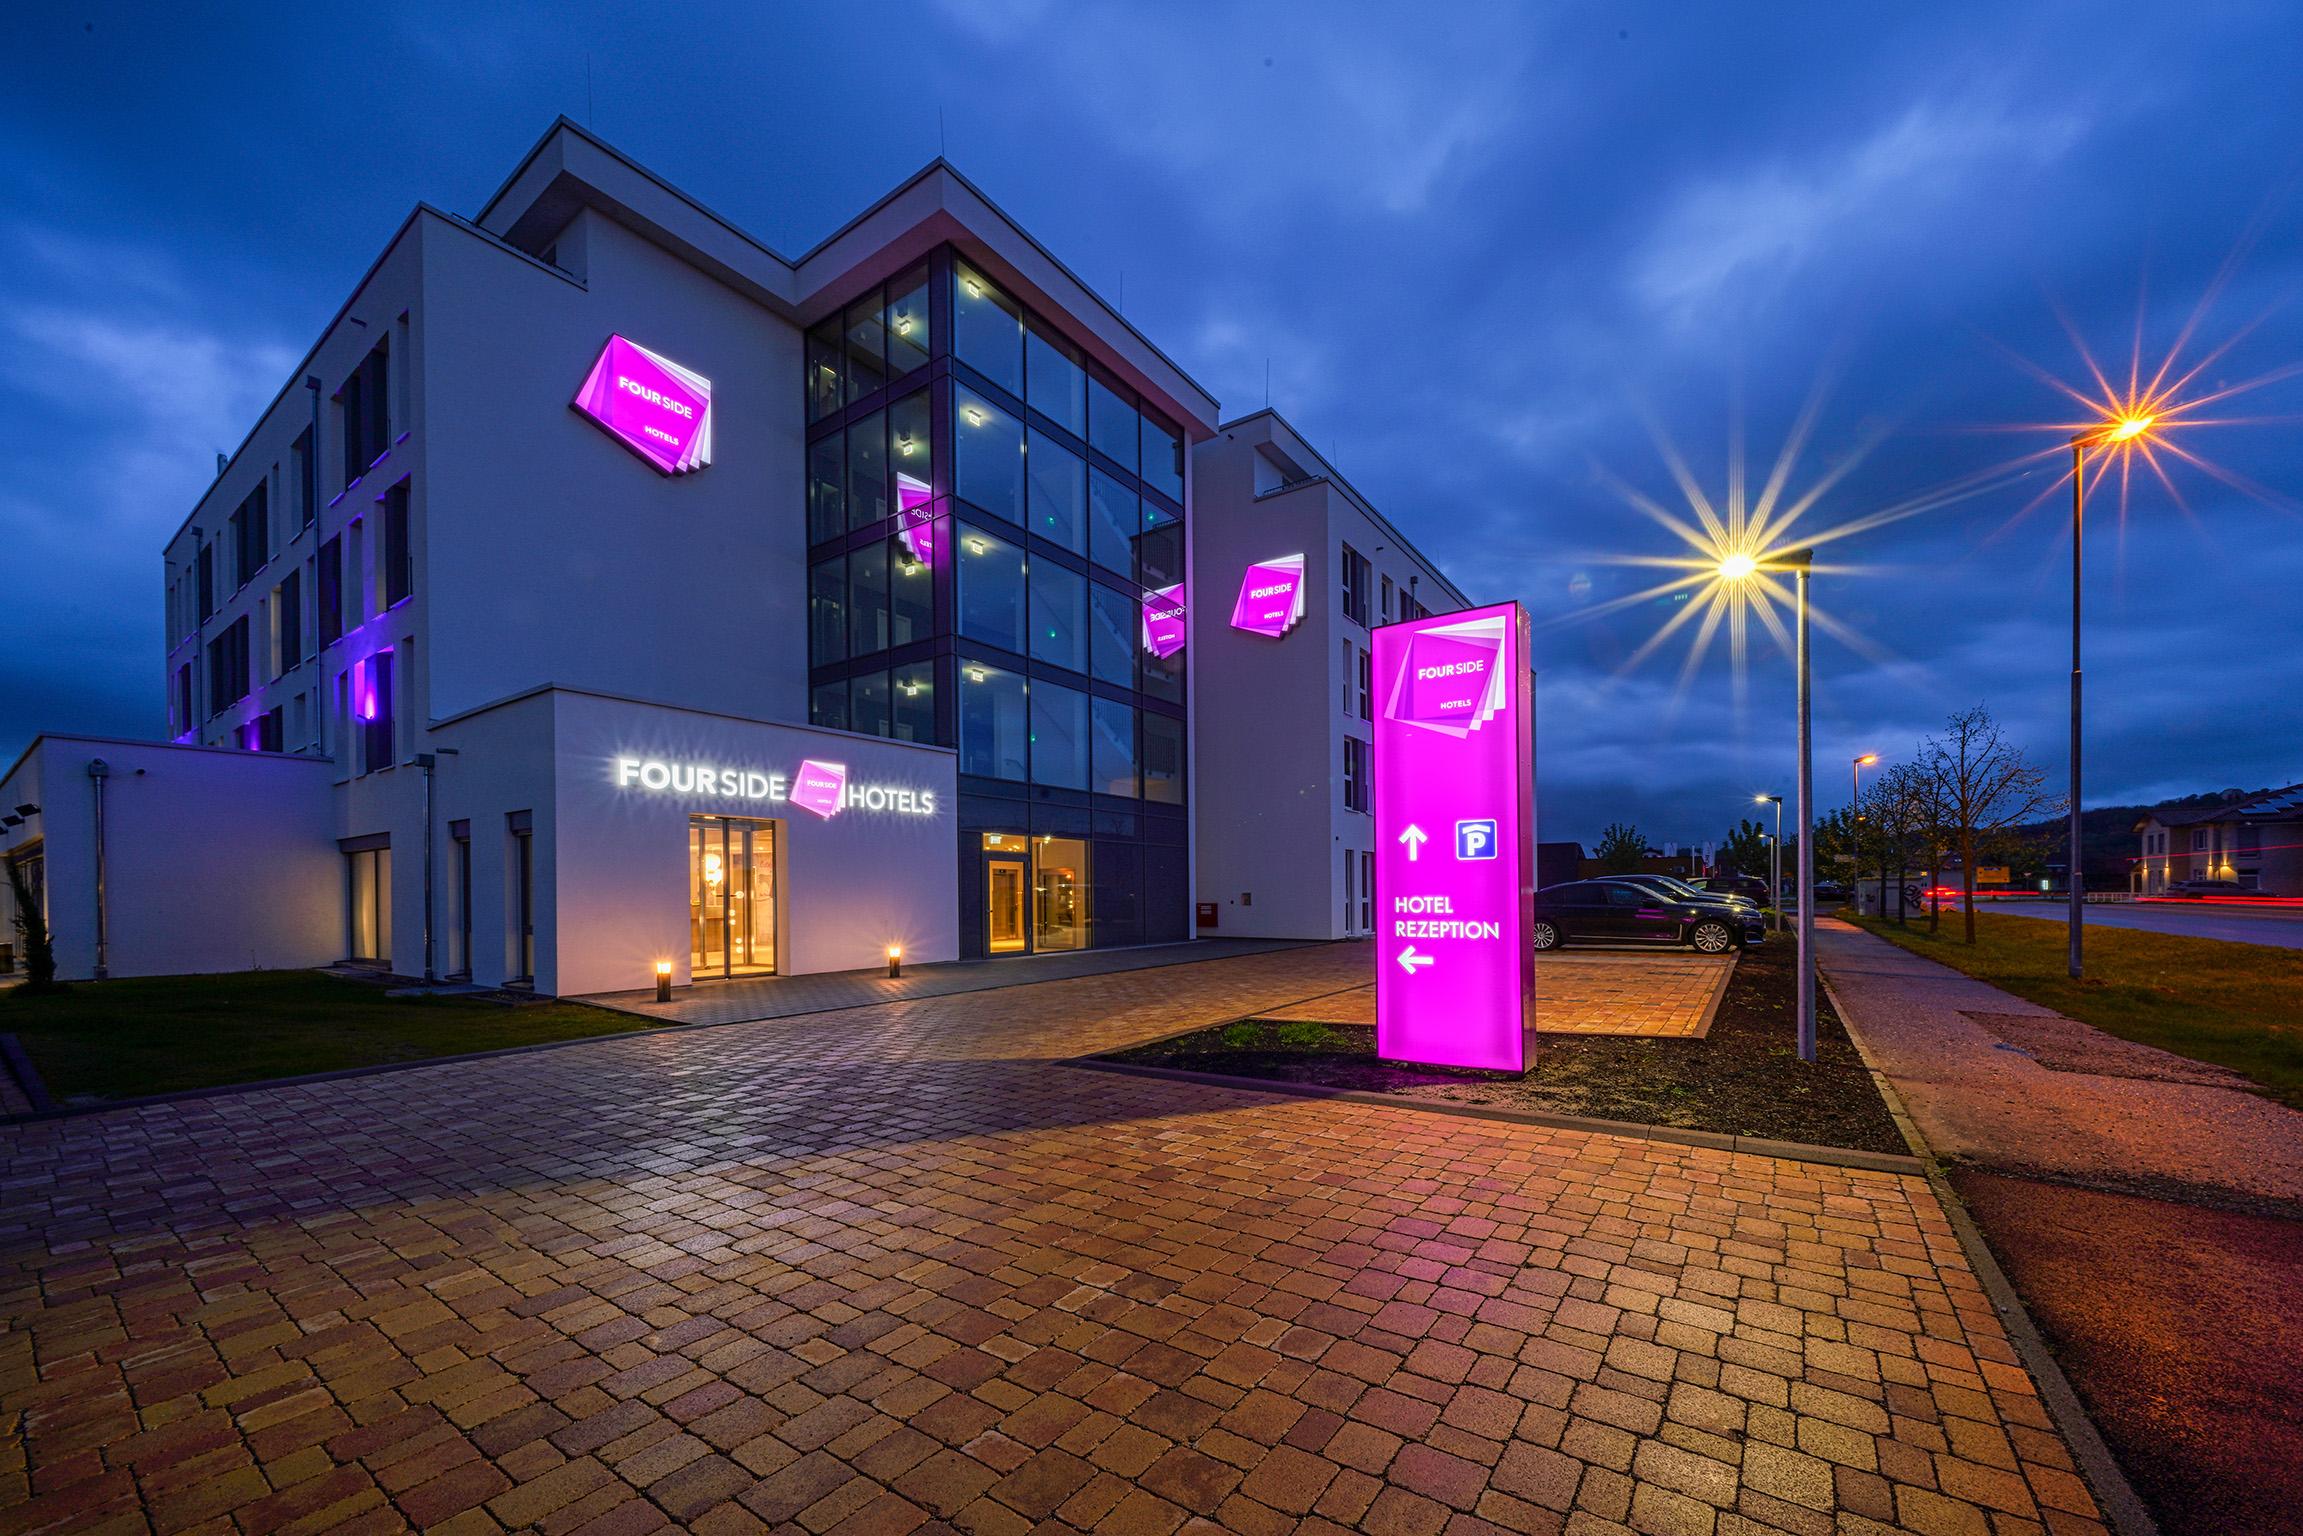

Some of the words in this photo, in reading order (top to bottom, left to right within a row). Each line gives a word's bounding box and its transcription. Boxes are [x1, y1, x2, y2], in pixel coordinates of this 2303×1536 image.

[644, 426, 679, 446] HOTELS
[1440, 699, 1472, 710] HOTELS
[849, 784, 934, 815] HOTELS
[1467, 831, 1486, 857] P
[1395, 896, 1454, 914] HOTEL
[1395, 920, 1500, 940] REZEPTION
